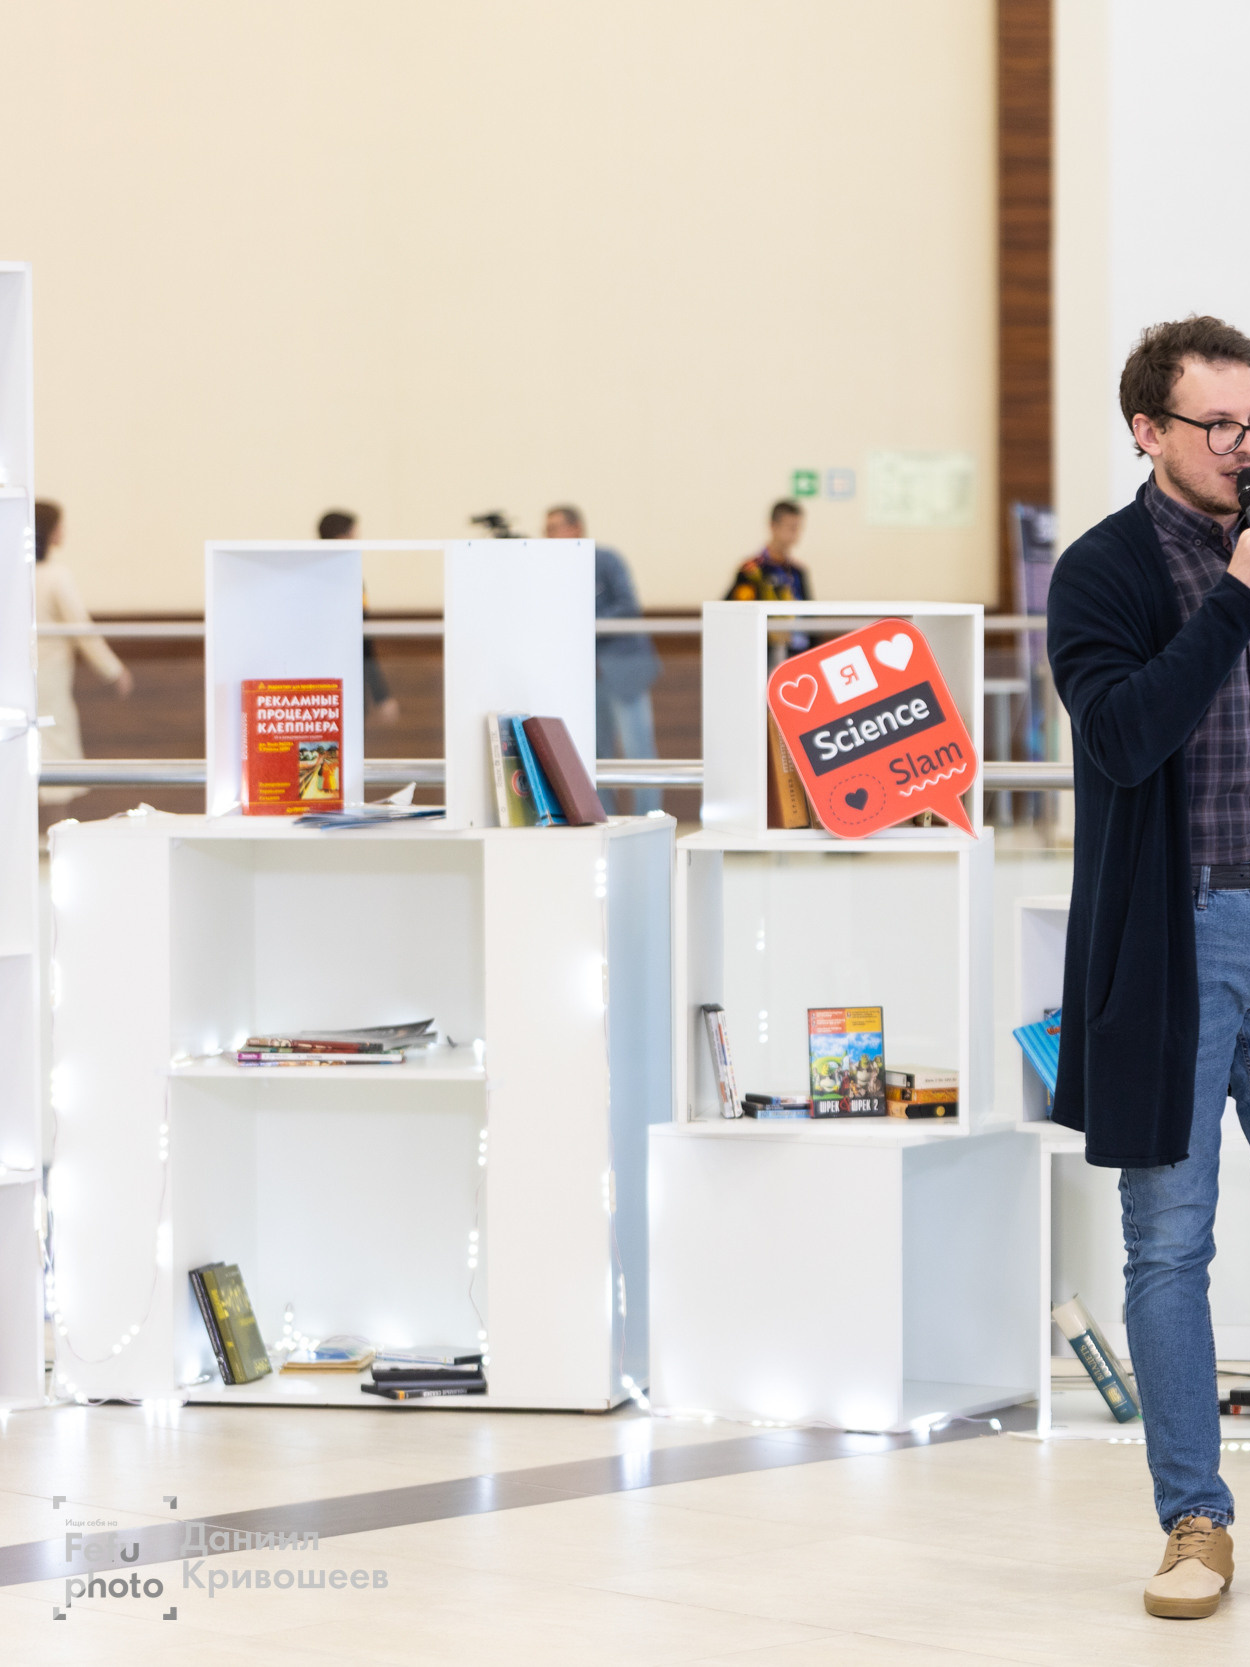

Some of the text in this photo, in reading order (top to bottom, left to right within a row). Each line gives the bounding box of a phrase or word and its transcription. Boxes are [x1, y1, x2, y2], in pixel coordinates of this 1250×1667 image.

[840, 663, 860, 686] Я
[257, 695, 340, 707] РЕКЛАМНЫЕ
[257, 708, 340, 721] ПРОЦЕДУРЫ
[257, 721, 340, 734] КЛЕППНЕРА
[813, 698, 930, 761] Science
[888, 741, 964, 786] Slam
[820, 1101, 840, 1113] ШРЕК
[851, 1099, 871, 1111] ШРЕК
[873, 1099, 879, 1110] 2
[1081, 1345, 1105, 1382] ВЛАДЕТЬ
